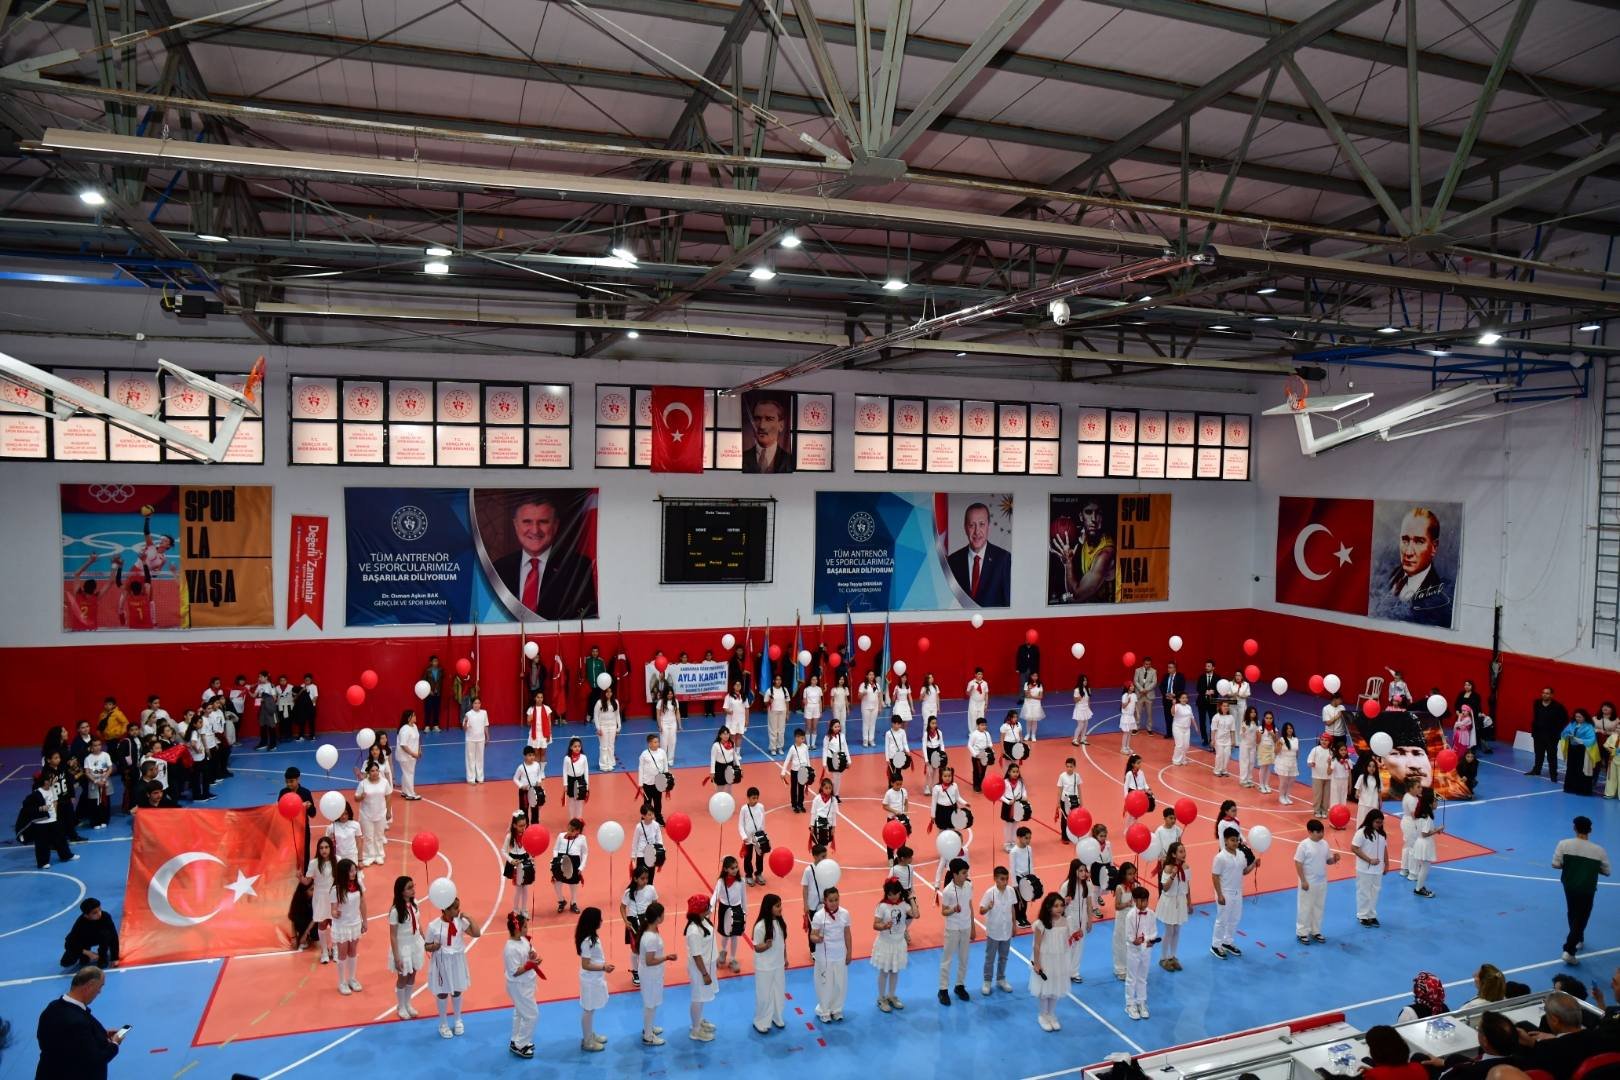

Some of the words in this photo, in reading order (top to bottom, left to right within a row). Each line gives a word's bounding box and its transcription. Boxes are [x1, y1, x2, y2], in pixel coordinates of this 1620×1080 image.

[187, 526, 210, 559] LA
[306, 525, 319, 556] Değerli
[1122, 525, 1135, 549] LA
[370, 552, 393, 562] TÜM
[395, 552, 449, 562] ANTRENÖR
[833, 548, 850, 557] TÜM
[852, 548, 888, 557] ANTRENÖR
[359, 563, 371, 572] VE
[374, 563, 460, 572] SPORCULARIMIZA
[363, 574, 409, 583] BAŞARILAR
[411, 573, 457, 581] DİLİYORUM
[1120, 558, 1148, 586] YAŞA
[185, 570, 236, 607] YAŞA
[305, 560, 317, 604] Zamanlar
[678, 674, 696, 682] AYLA
[699, 671, 726, 681] KARA'YI
